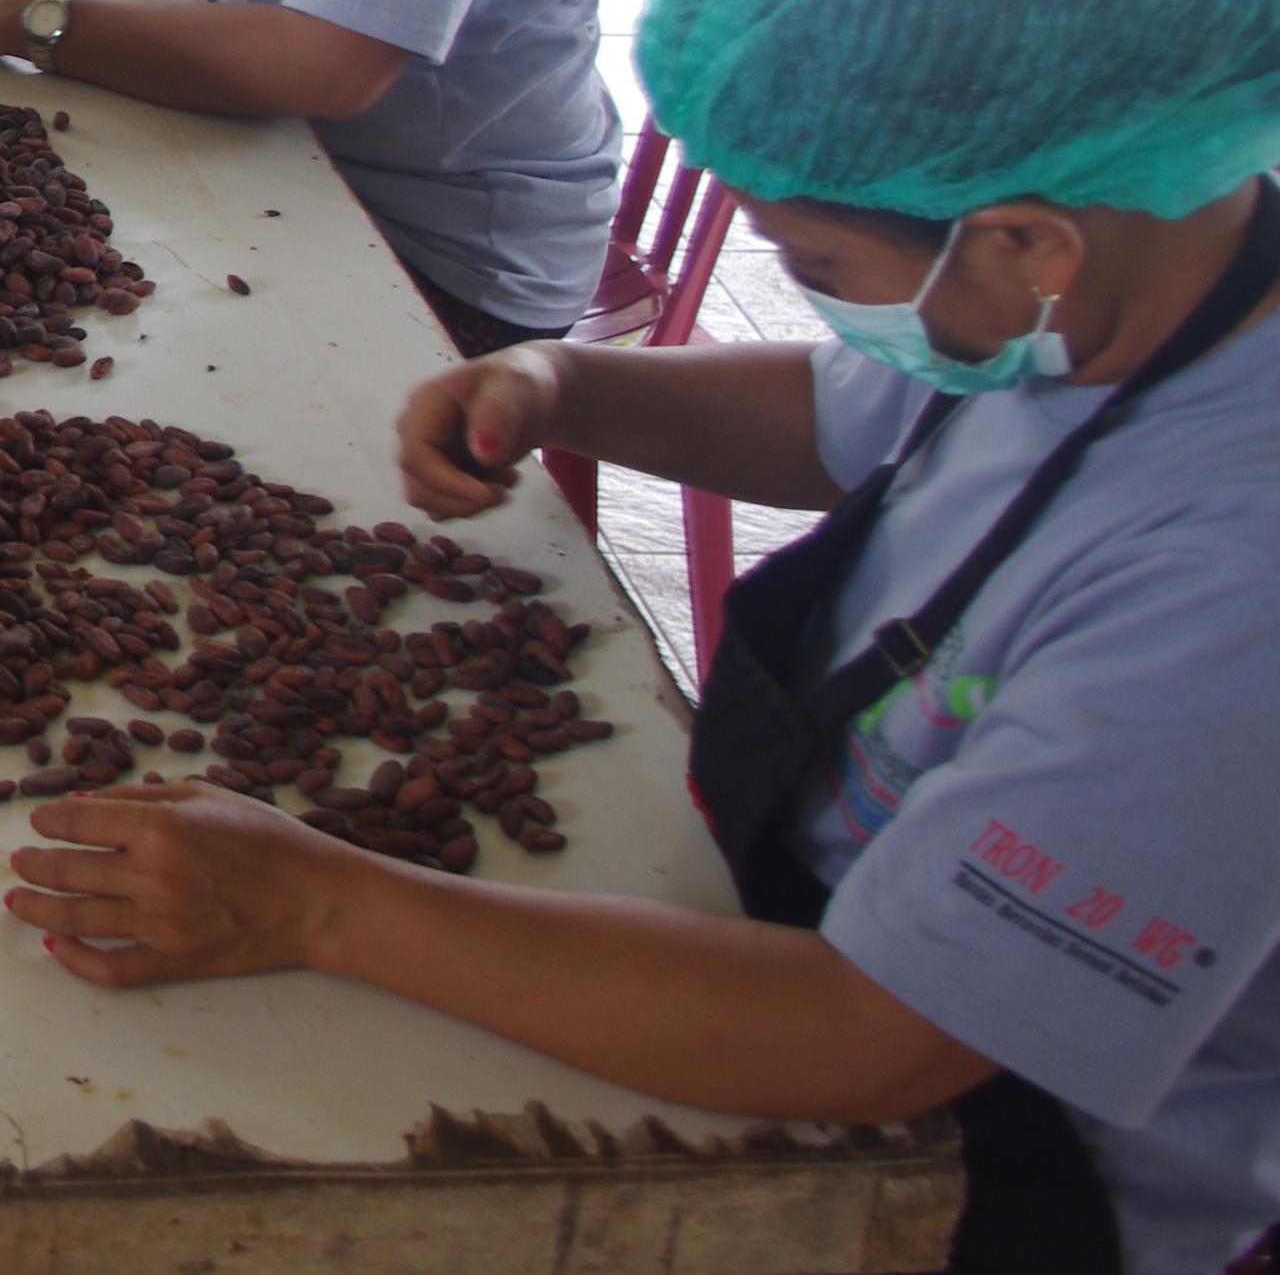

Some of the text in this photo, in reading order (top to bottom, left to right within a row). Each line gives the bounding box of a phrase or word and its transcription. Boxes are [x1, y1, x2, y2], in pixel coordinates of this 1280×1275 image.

[968, 818, 1198, 969] TRON 20 WG
